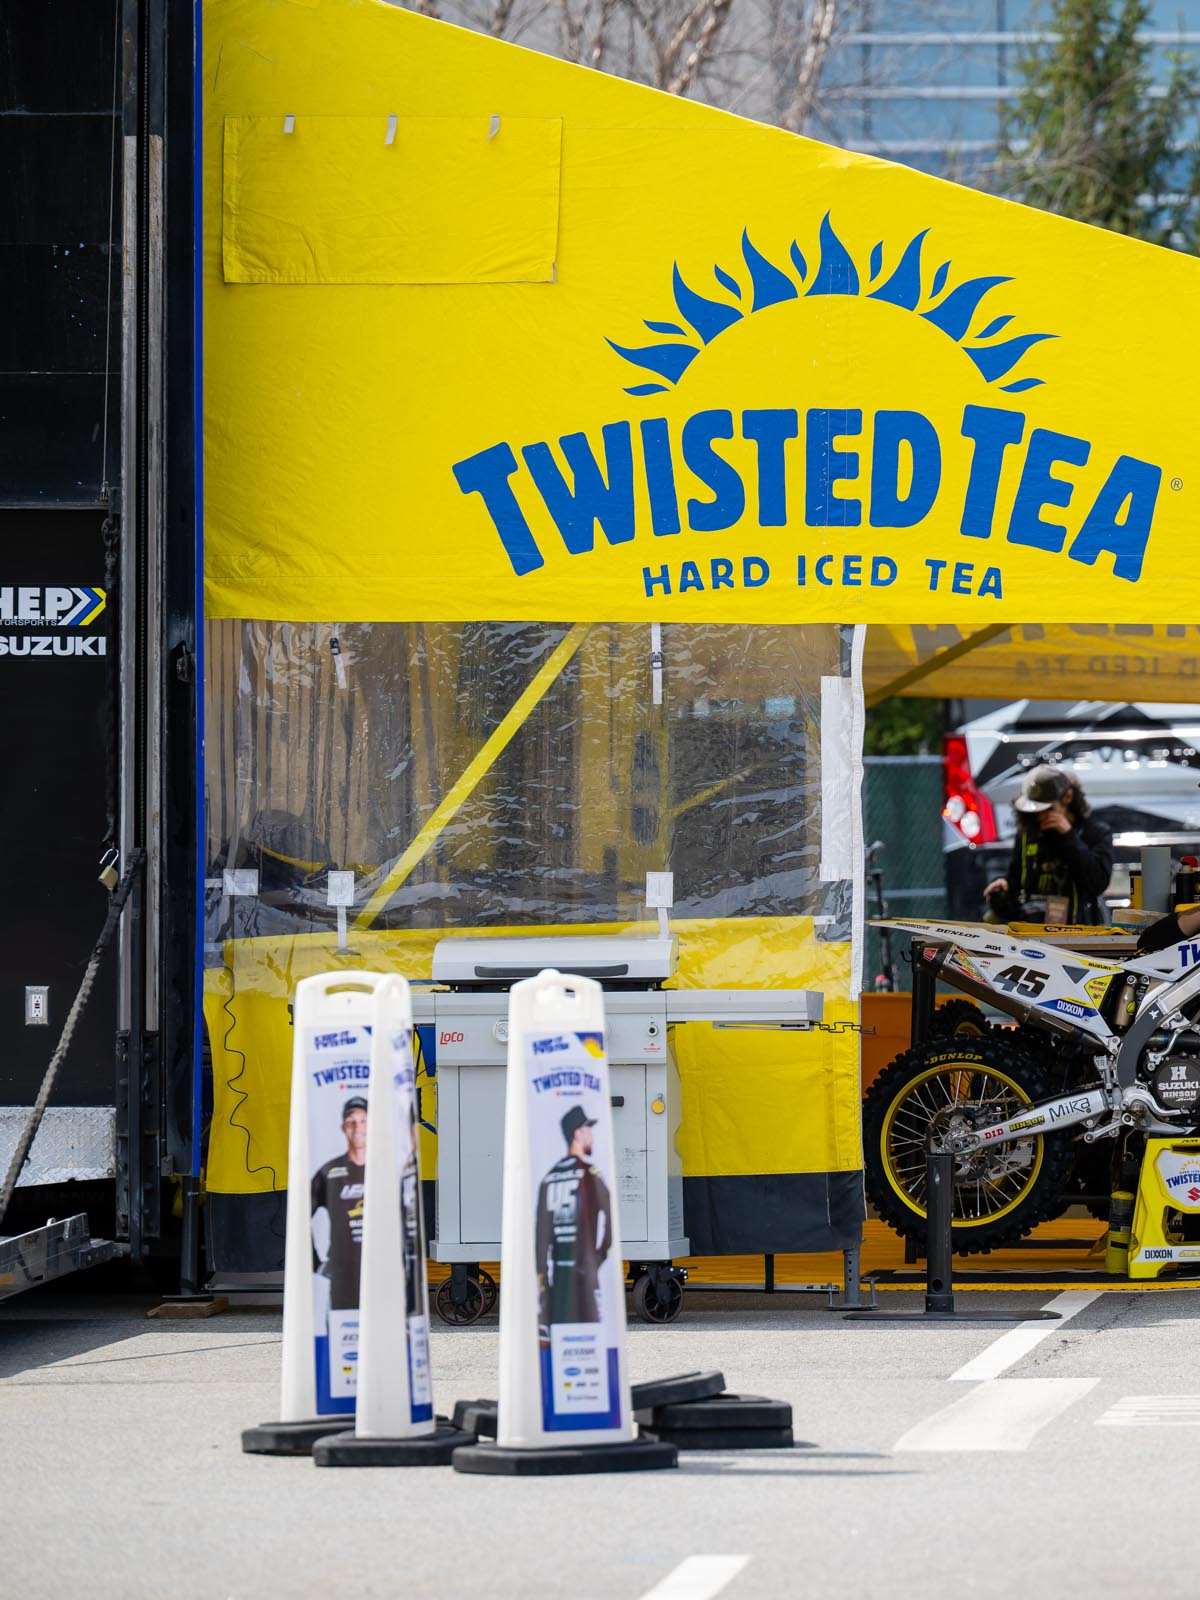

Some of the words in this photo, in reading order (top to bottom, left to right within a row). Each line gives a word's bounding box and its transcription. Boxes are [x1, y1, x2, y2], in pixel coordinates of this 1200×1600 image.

[453, 409, 940, 575] TWISTED
[961, 405, 1161, 581] TEA
[643, 556, 770, 597] HARD
[799, 556, 897, 587] ICED
[926, 559, 1002, 599] TEA
[936, 928, 981, 940] DUNLOP
[993, 965, 1050, 998] 45
[1056, 999, 1085, 1017] DIXXON
[930, 1052, 983, 1064] DUNLOP
[313, 1065, 370, 1087] TWISTED
[1158, 1081, 1199, 1090] SUZUKI
[1163, 1090, 1197, 1099] HINSON
[984, 1128, 1004, 1139] DID
[1144, 1249, 1173, 1260] DIXXON
